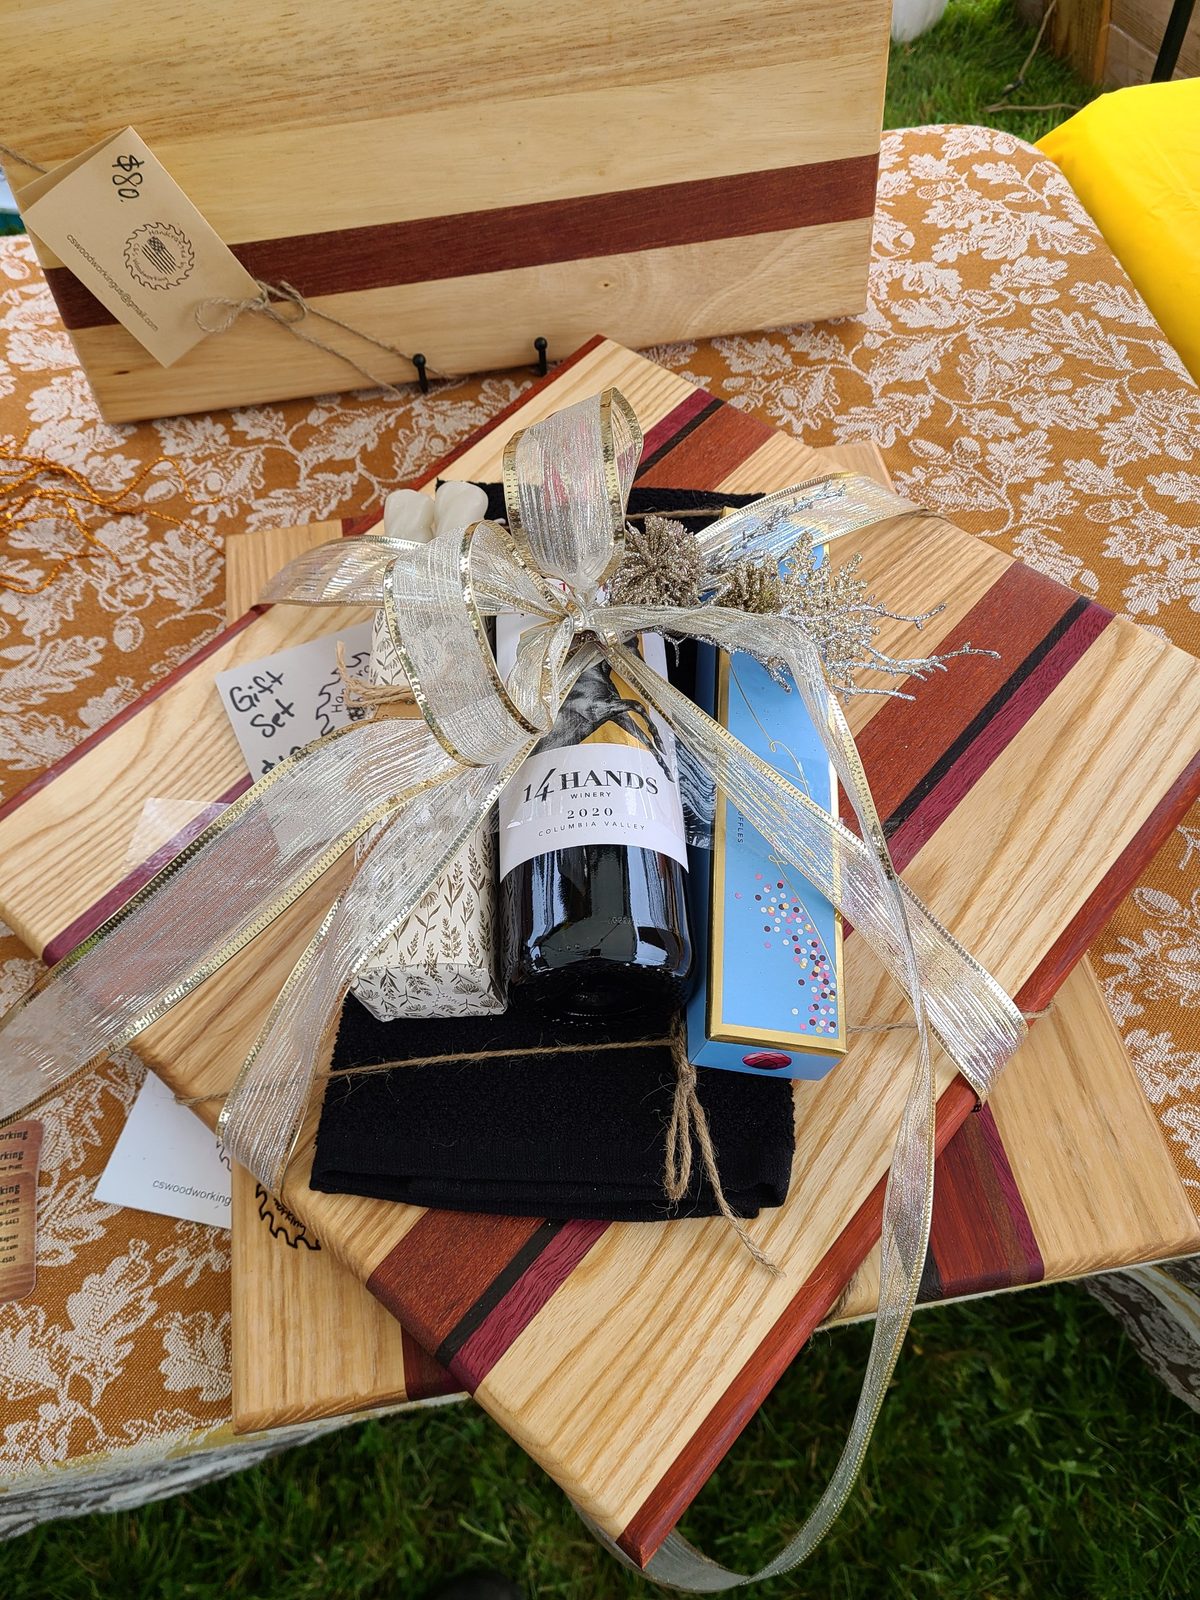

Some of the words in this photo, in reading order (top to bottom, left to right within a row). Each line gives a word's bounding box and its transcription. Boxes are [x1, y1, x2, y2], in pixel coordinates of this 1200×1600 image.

[66, 234, 159, 332] cswoodworkingus@gmail.com
[229, 670, 284, 713] Gift
[250, 698, 296, 738] Set
[523, 767, 557, 804] 14
[558, 769, 660, 796] HANDS
[570, 790, 613, 800] WINERY
[538, 821, 597, 837] COLUMBIA
[603, 820, 646, 831] VALLEY
[567, 807, 614, 820] 2020
[152, 1179, 232, 1207] cswoodworking
